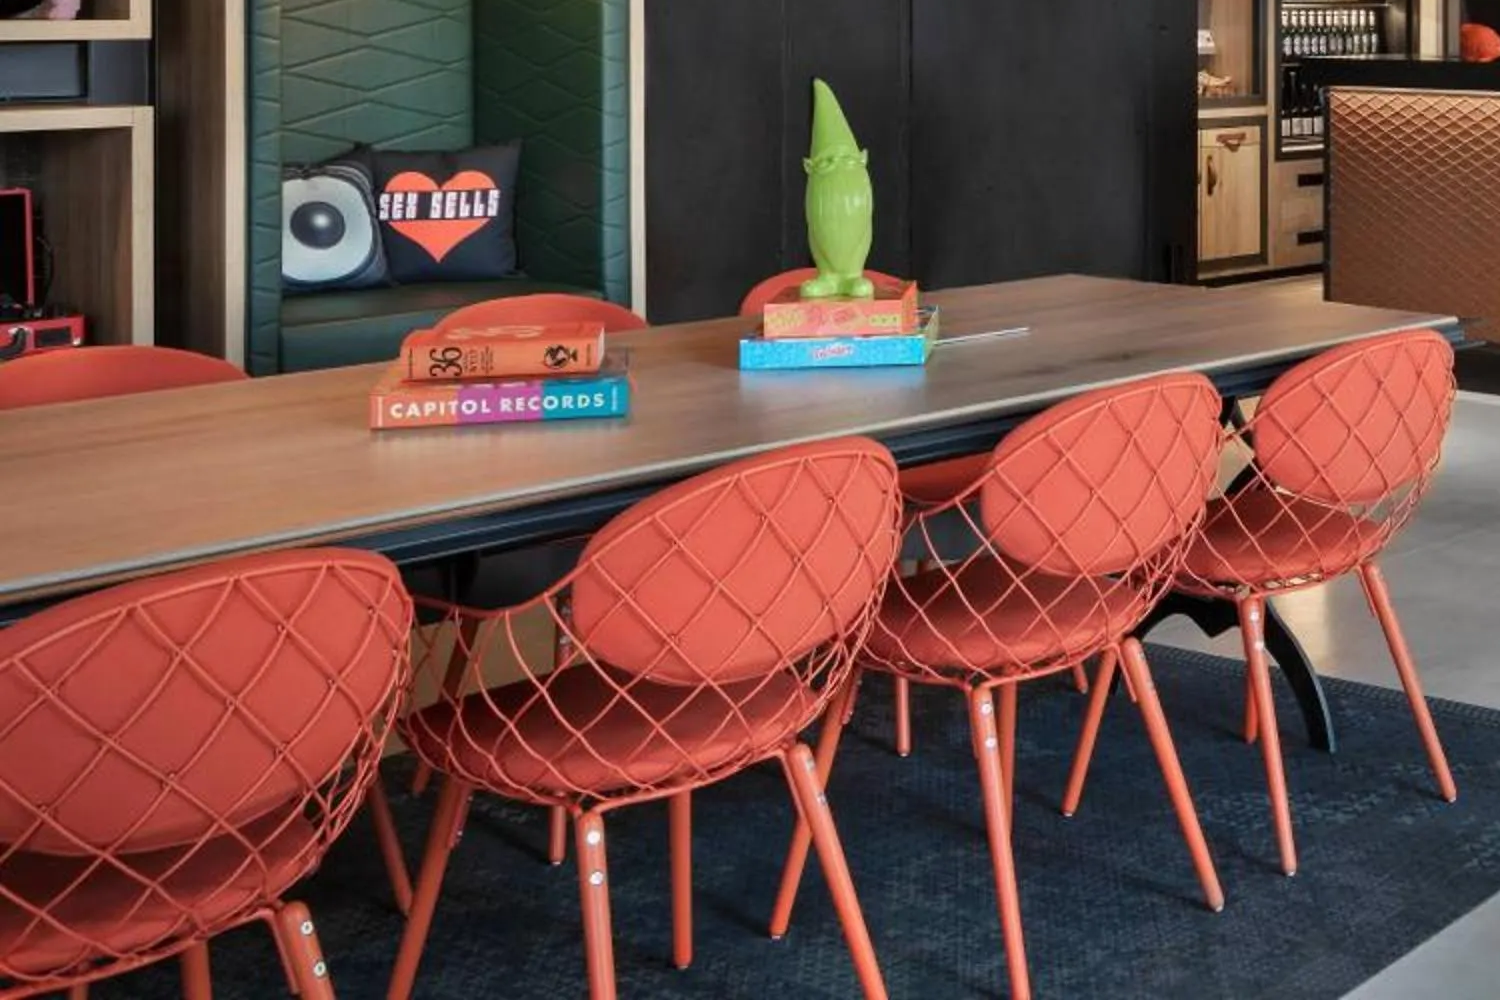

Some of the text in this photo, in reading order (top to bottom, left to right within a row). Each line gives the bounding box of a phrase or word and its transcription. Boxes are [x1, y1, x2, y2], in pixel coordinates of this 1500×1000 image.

[379, 189, 500, 220] SEX SELLS
[429, 346, 463, 378] 36
[390, 399, 491, 418] CAPITOL
[500, 393, 605, 413] RECORDS
